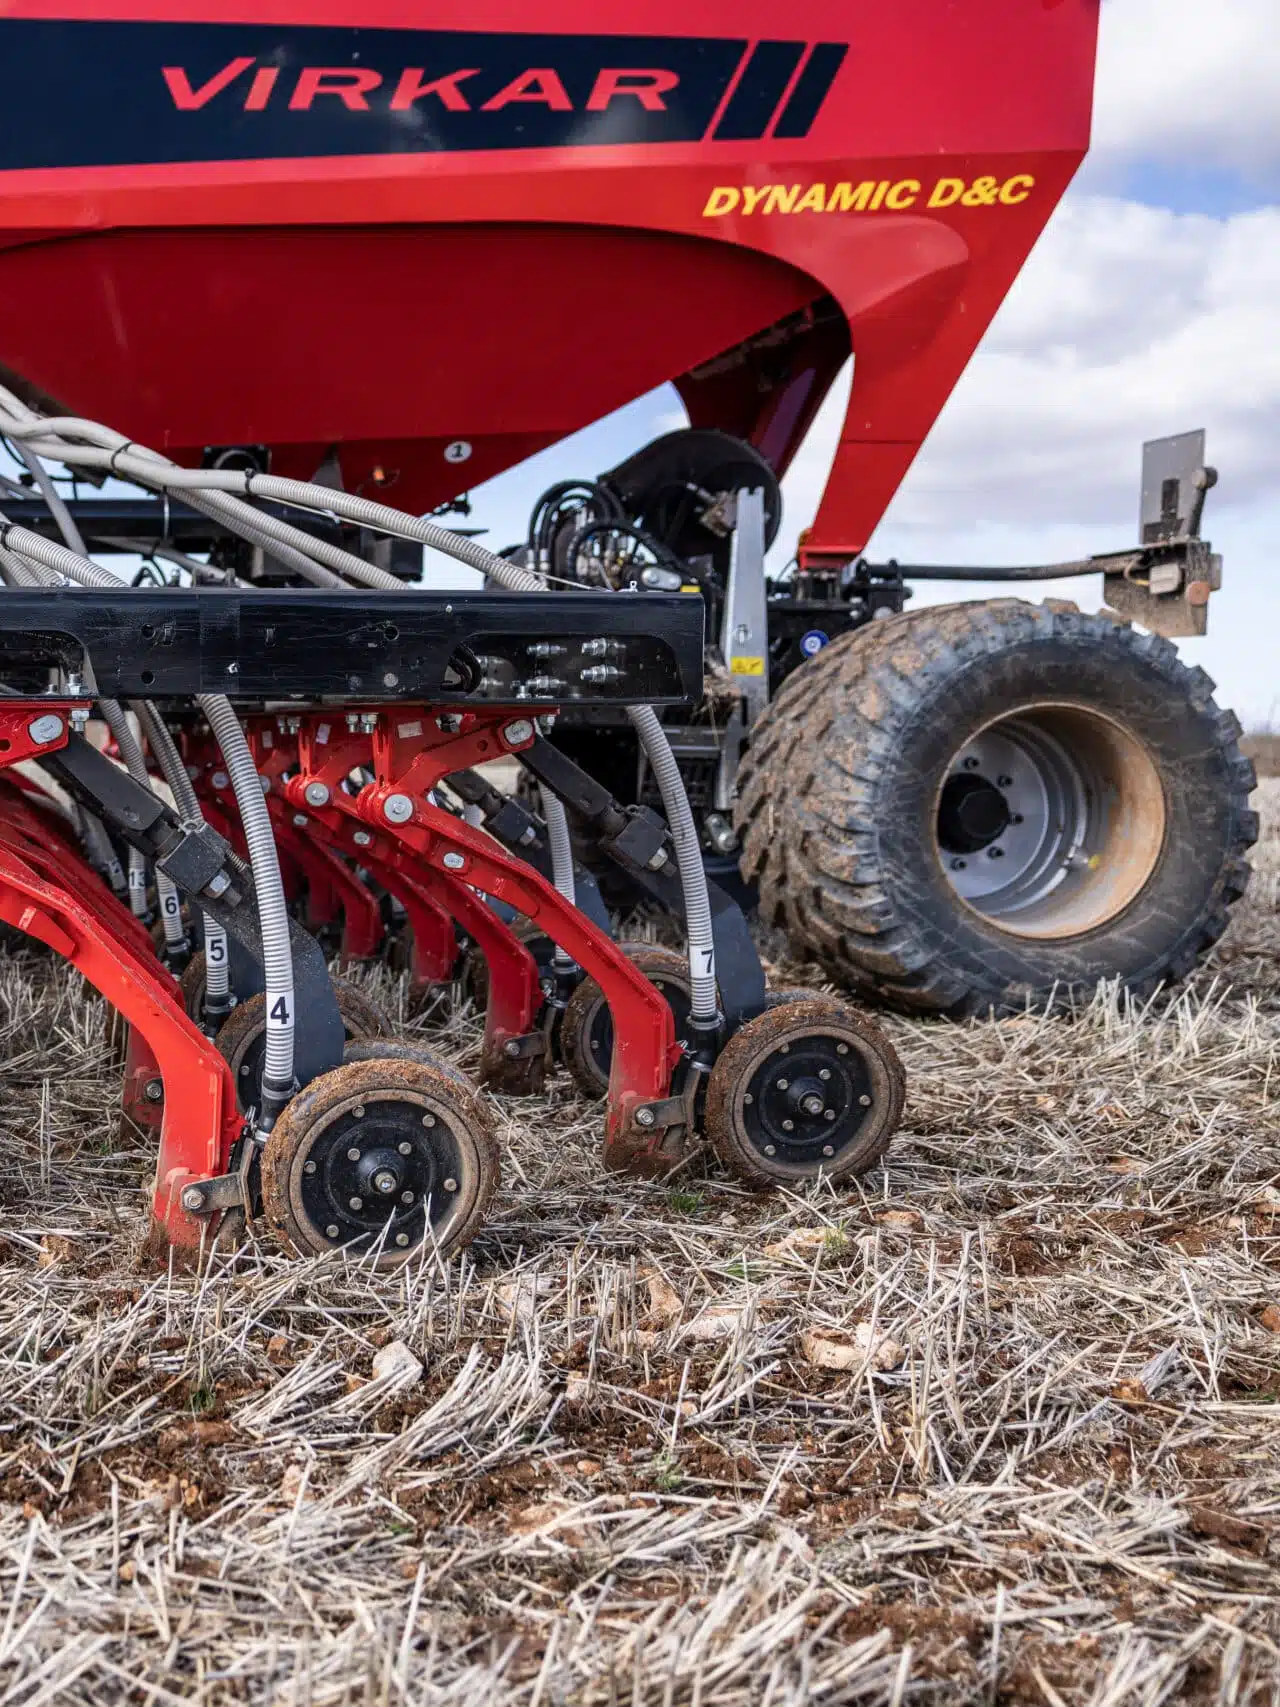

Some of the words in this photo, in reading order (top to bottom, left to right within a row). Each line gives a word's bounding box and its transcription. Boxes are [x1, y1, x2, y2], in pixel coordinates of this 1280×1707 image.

[161, 57, 681, 112] VIRKAR
[702, 179, 921, 217] DYNAMIC
[927, 173, 1035, 209] D&C
[452, 444, 464, 458] 1
[165, 896, 177, 914] 6
[210, 938, 224, 961] 5
[701, 949, 713, 974] 7
[270, 996, 290, 1025] 4
